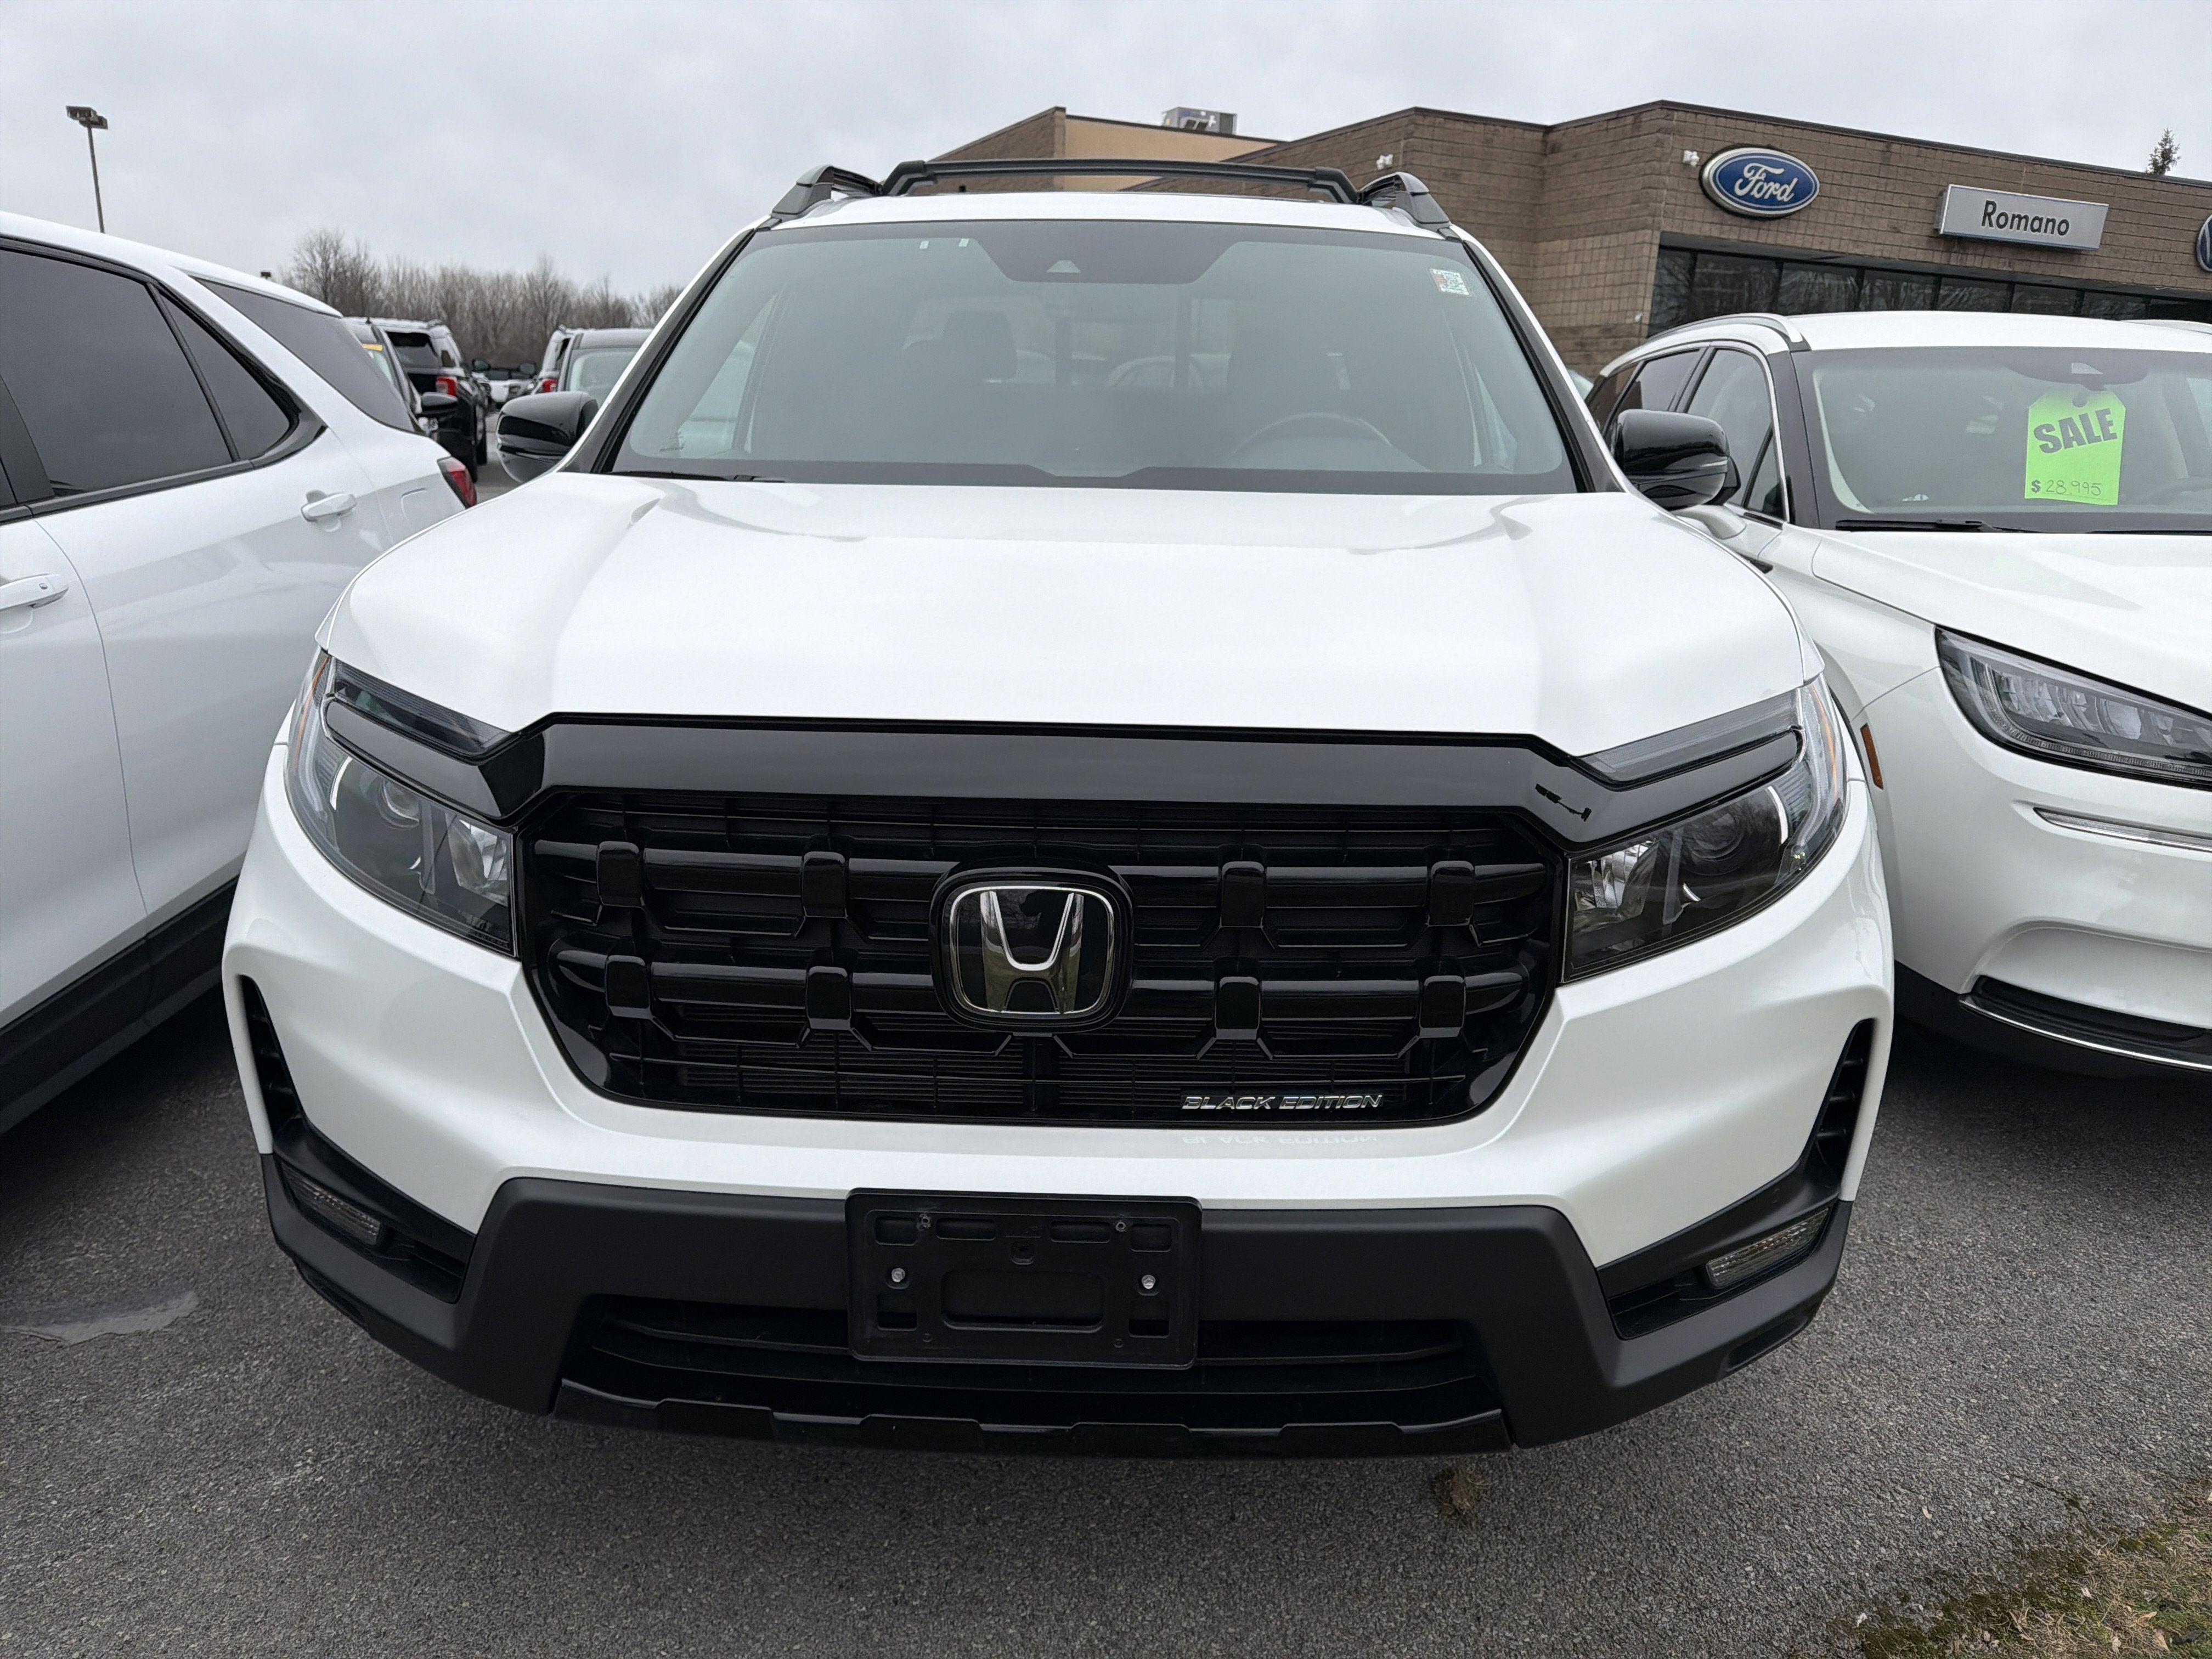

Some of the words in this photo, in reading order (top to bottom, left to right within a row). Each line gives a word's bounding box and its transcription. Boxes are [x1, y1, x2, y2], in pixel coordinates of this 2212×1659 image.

[1735, 163, 1798, 202] Ford
[1981, 200, 2069, 236] Romano
[2033, 408, 2118, 453] SALE
[1182, 1097, 1276, 1109] BLACK
[1278, 1094, 1383, 1109] EDITION
